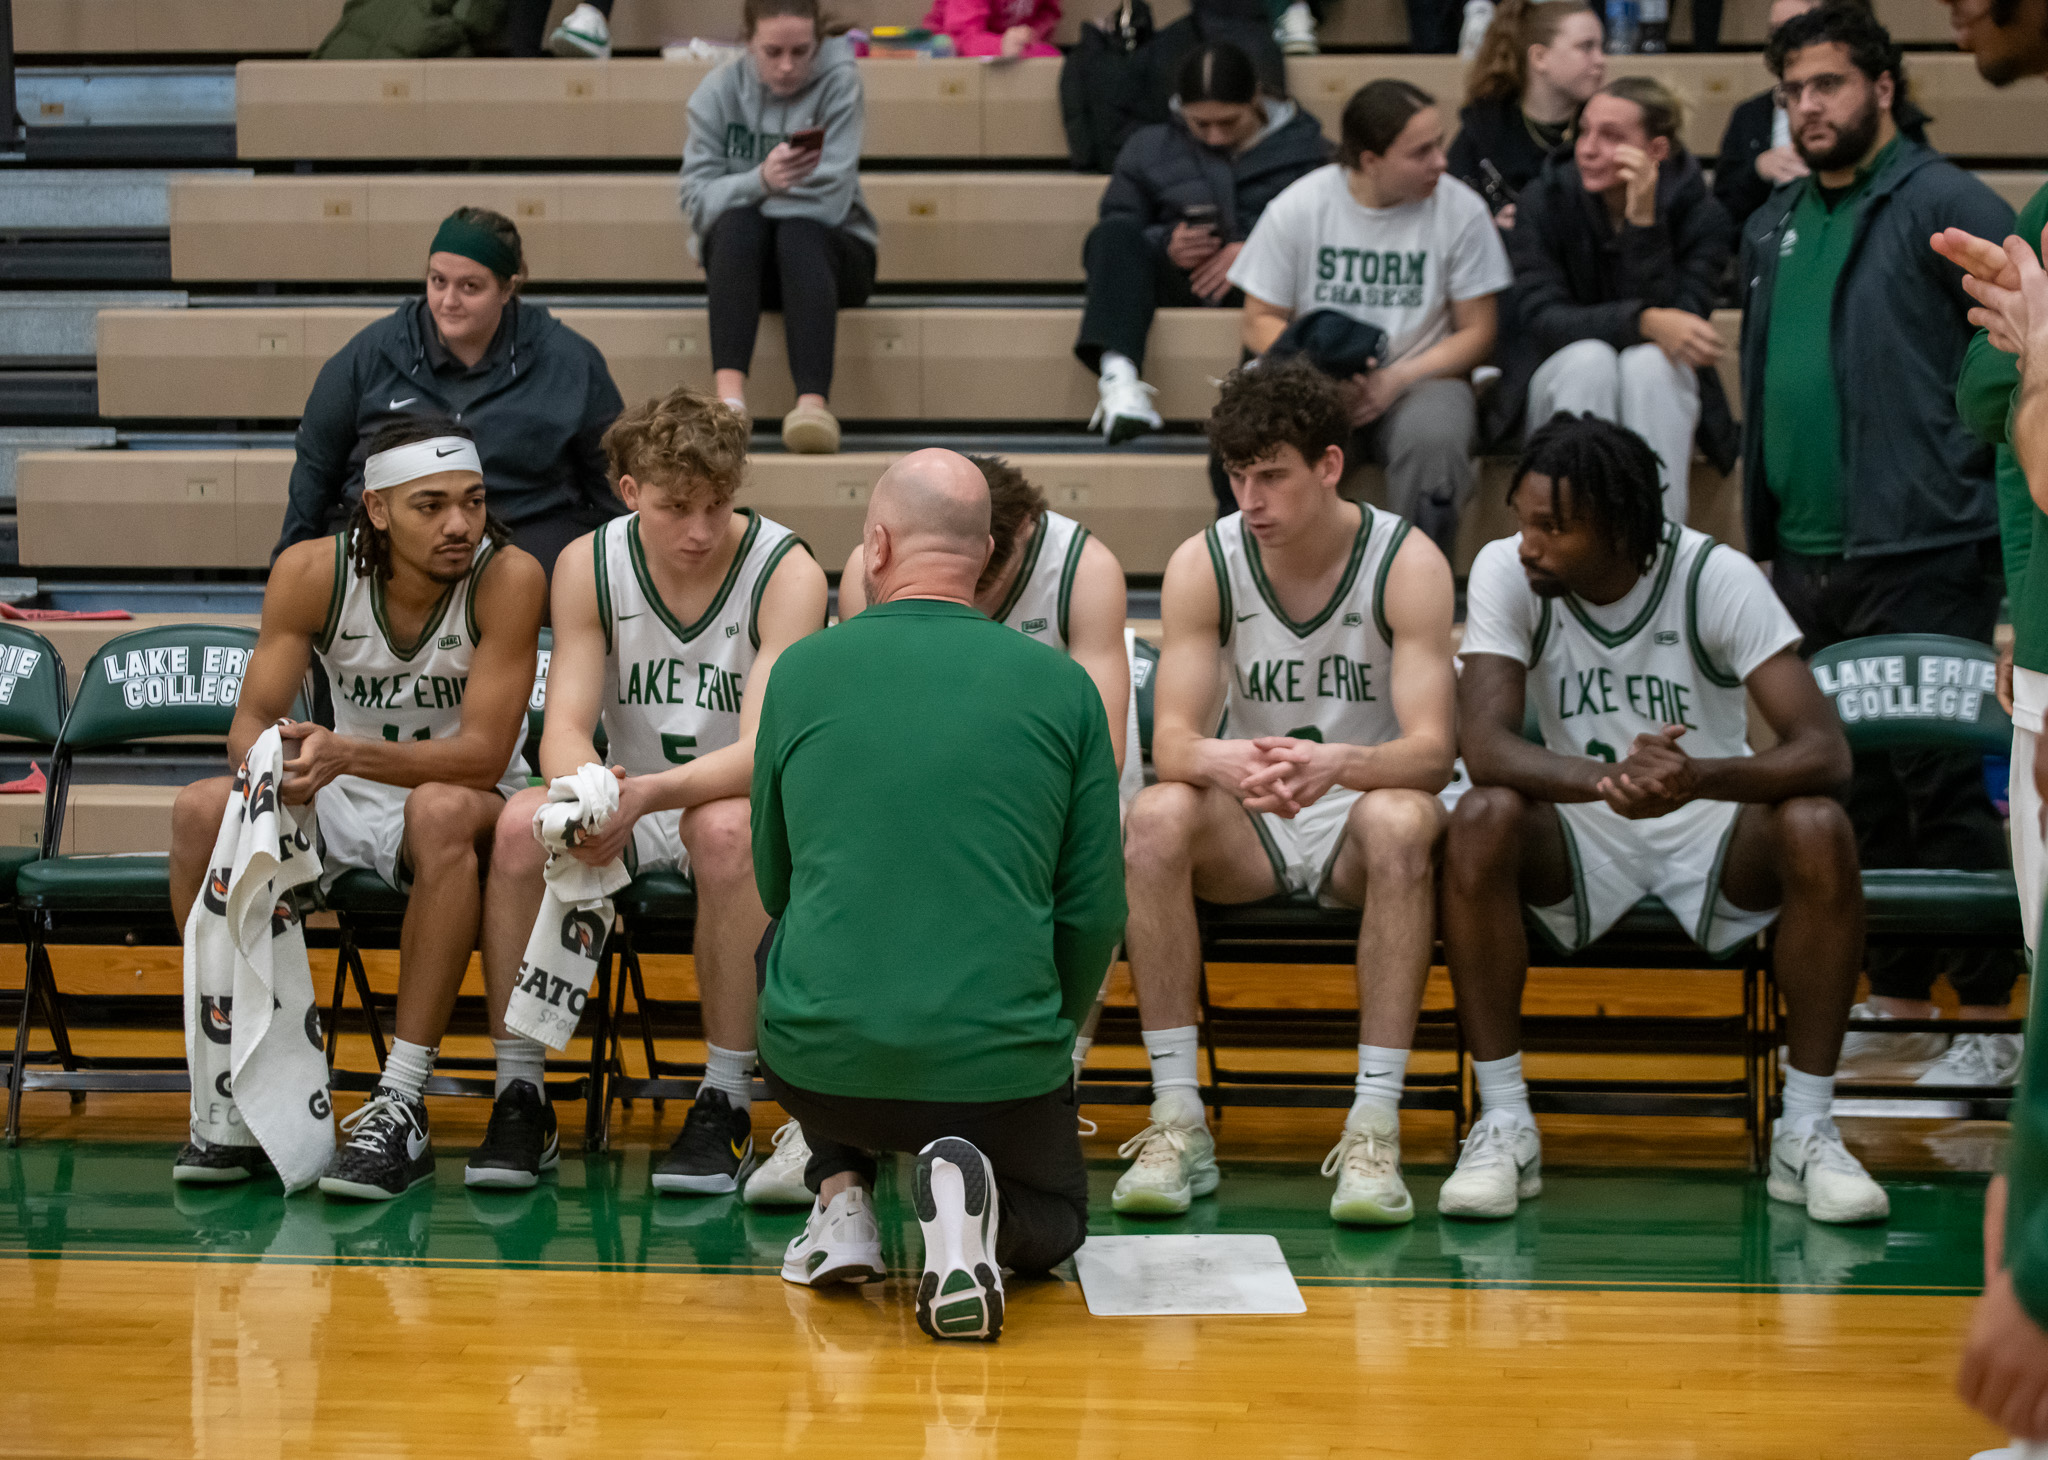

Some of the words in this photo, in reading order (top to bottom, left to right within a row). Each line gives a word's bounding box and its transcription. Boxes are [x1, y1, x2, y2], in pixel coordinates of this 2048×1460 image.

[1318, 246, 1427, 285] STORM
[104, 646, 190, 684] LAKE
[203, 646, 254, 677] ER
[1235, 659, 1305, 702] LAKE
[1317, 654, 1376, 701] ERIE
[1812, 655, 1906, 698] LAKE
[1917, 655, 1997, 693] ERIE
[1625, 675, 1698, 730] ERIE
[1836, 684, 1984, 724] COLLEGE
